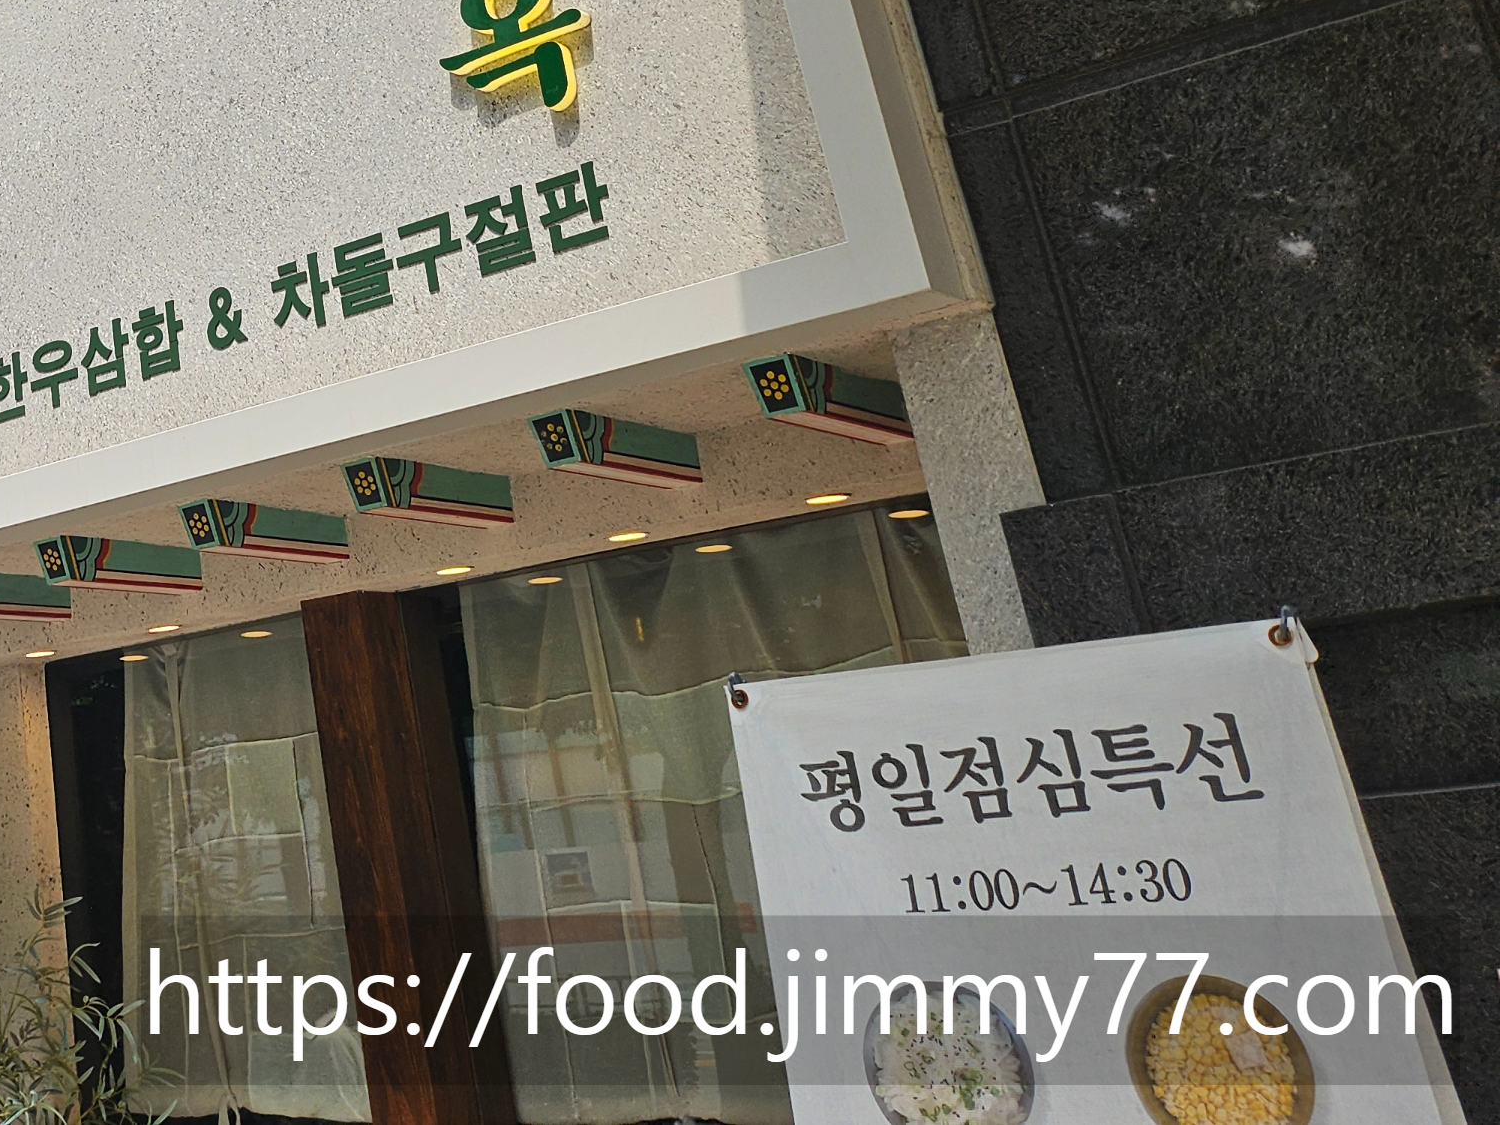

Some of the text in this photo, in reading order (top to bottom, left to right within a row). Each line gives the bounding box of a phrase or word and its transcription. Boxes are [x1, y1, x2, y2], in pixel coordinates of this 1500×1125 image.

[206, 286, 246, 350] &
[272, 160, 611, 330] 차돌구절판
[799, 712, 1266, 833] 평일점심특선
[900, 858, 1193, 914] 11:00~14:30
